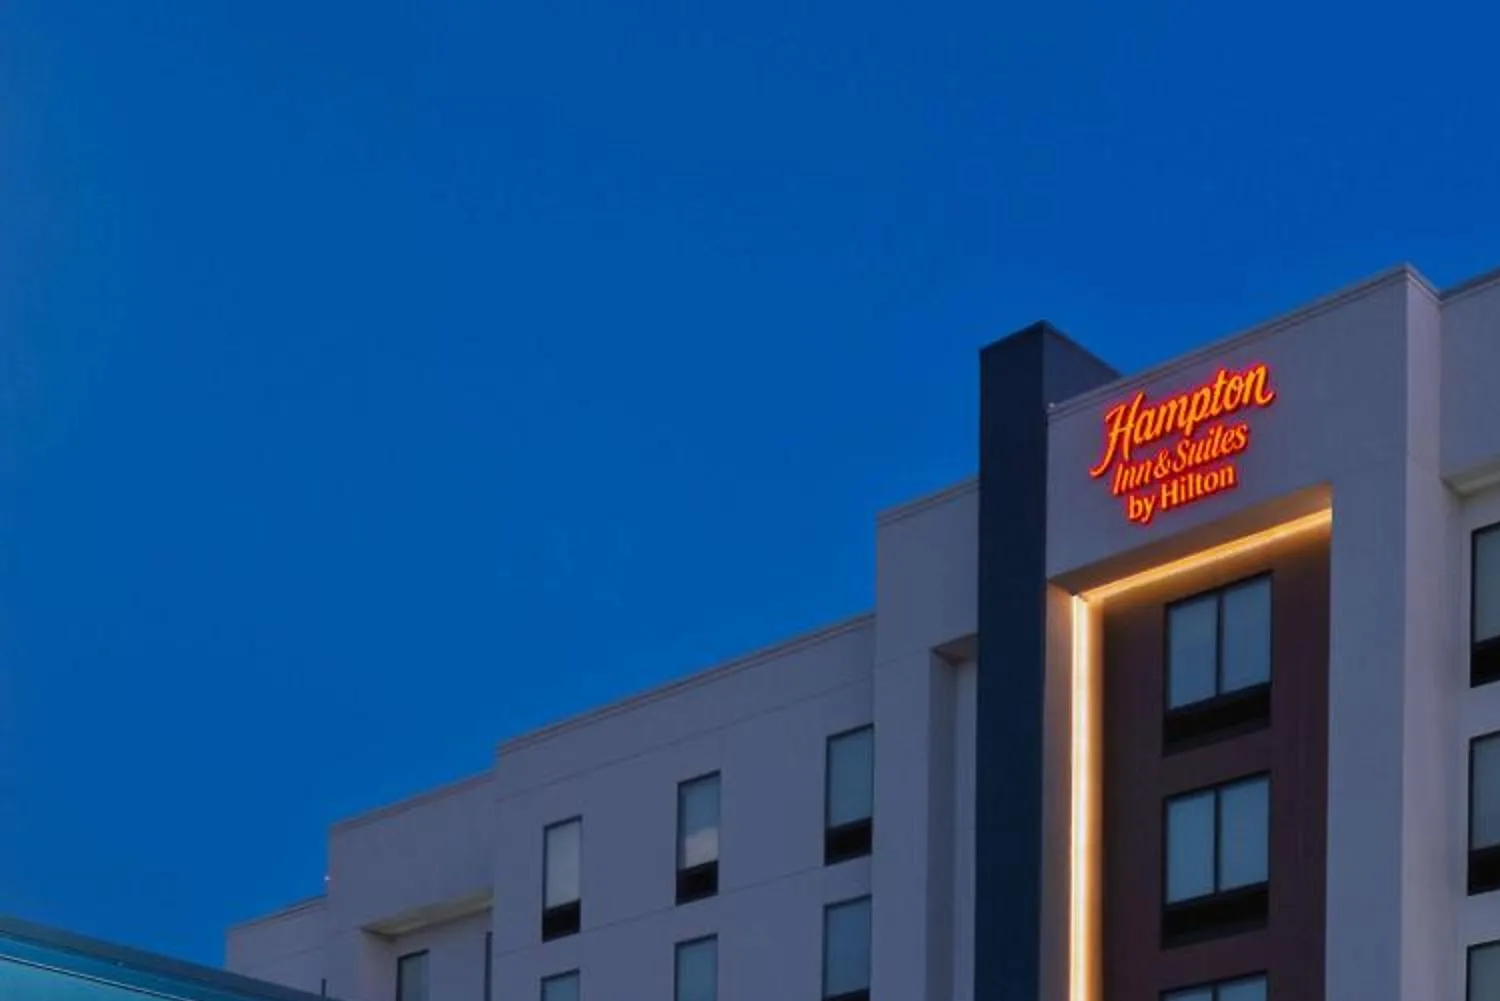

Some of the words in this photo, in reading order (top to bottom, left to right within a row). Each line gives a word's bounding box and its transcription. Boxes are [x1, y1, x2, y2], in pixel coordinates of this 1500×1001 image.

[1089, 362, 1276, 479] Hampton
[1112, 460, 1154, 496] Inn
[1152, 448, 1173, 480] &
[1172, 422, 1249, 473] Suites
[1128, 494, 1156, 524] by
[1160, 464, 1236, 511] Hilton
